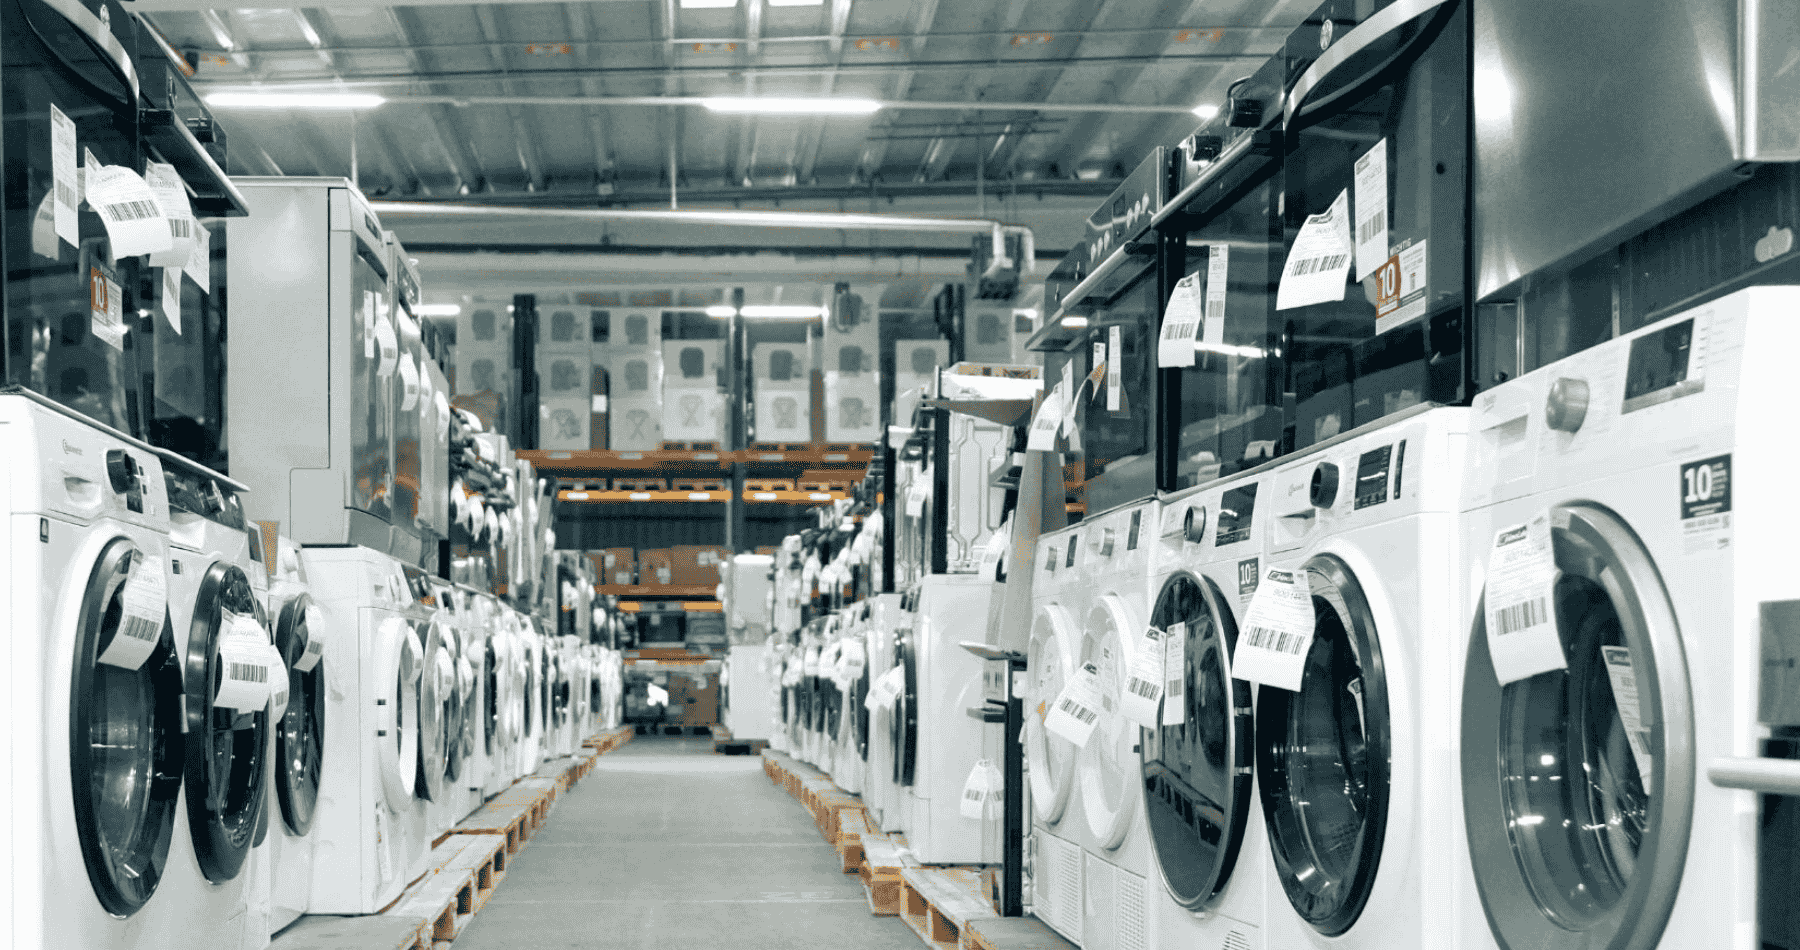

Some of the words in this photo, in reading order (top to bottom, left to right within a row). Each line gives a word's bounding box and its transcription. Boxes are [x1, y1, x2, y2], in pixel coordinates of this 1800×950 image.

[93, 276, 104, 308] 10
[1379, 263, 1396, 299] 10
[1684, 464, 1712, 503] 10
[1240, 563, 1251, 585] 10
